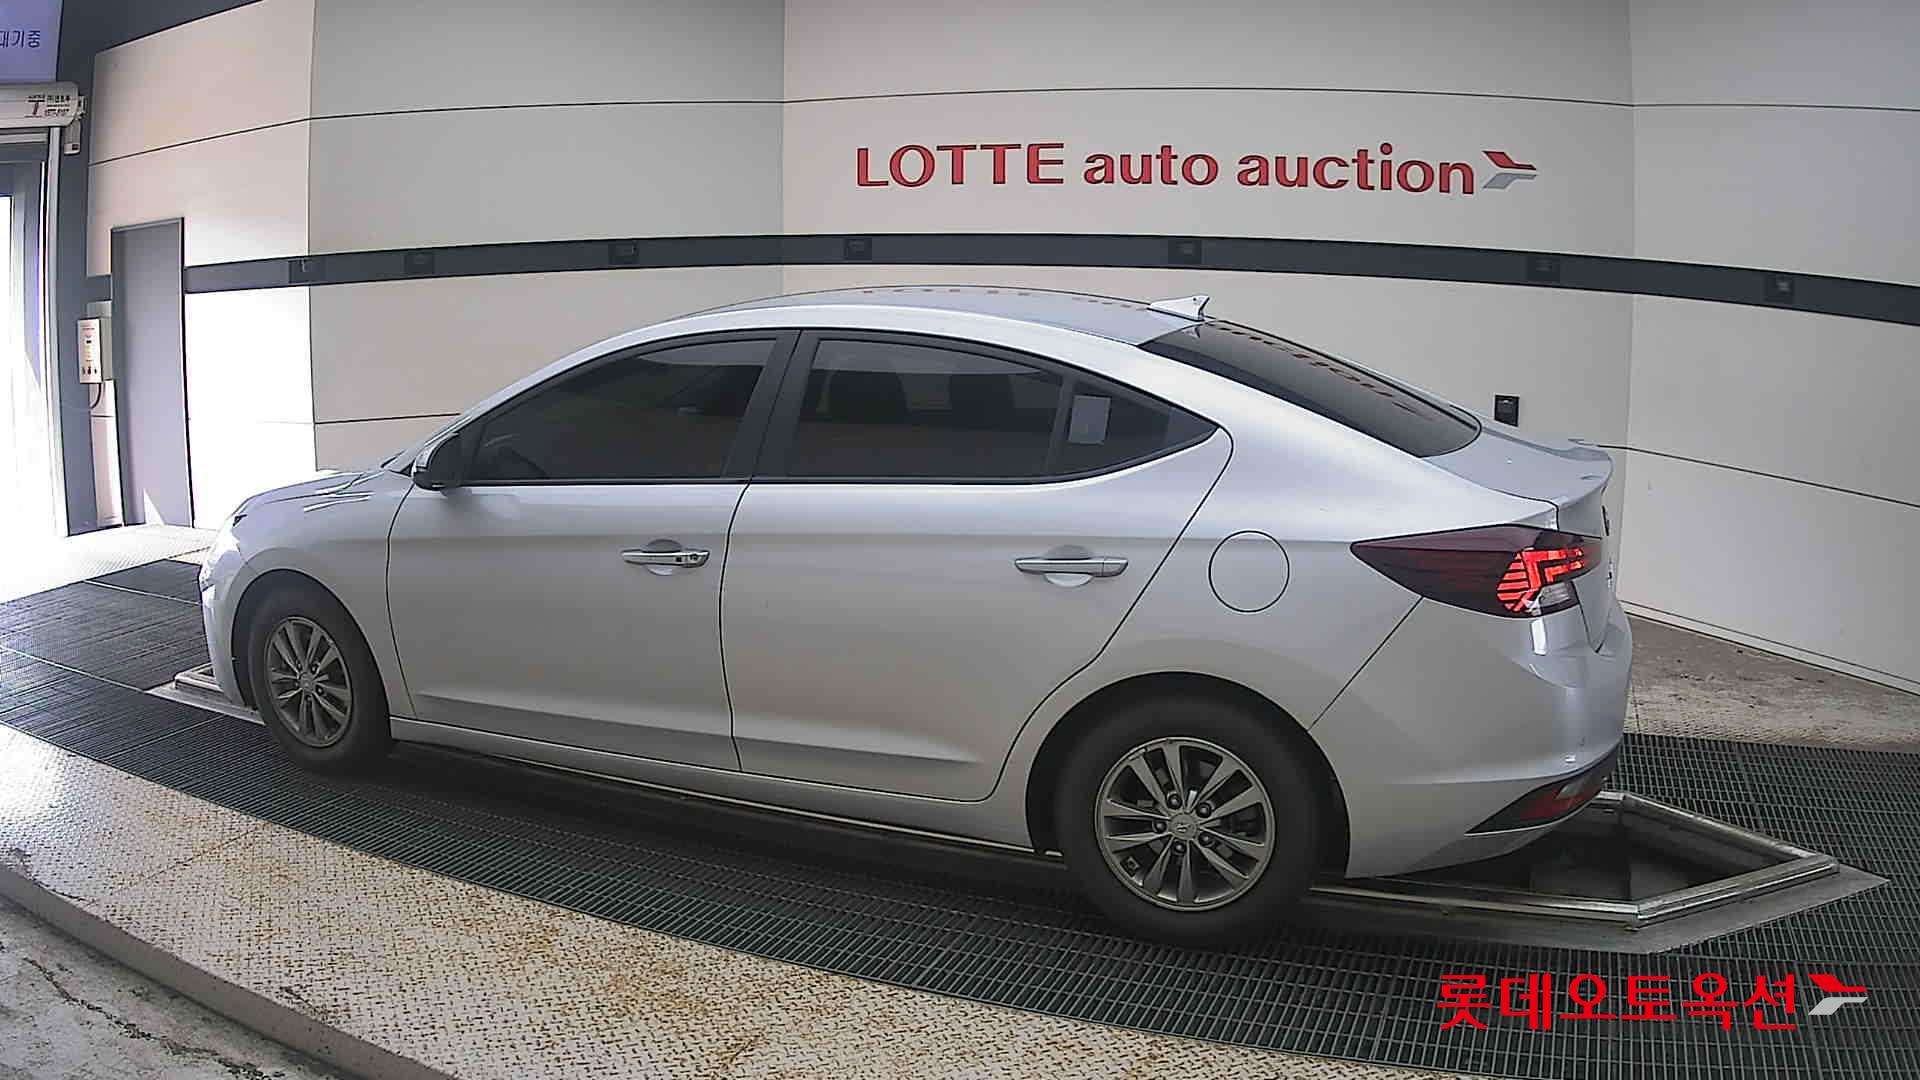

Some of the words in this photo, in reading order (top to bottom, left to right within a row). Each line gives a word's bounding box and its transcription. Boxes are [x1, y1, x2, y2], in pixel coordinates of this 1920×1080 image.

[857, 143, 1064, 187] LOTTE
[1083, 145, 1218, 185] auto
[1237, 142, 1475, 195] auction
